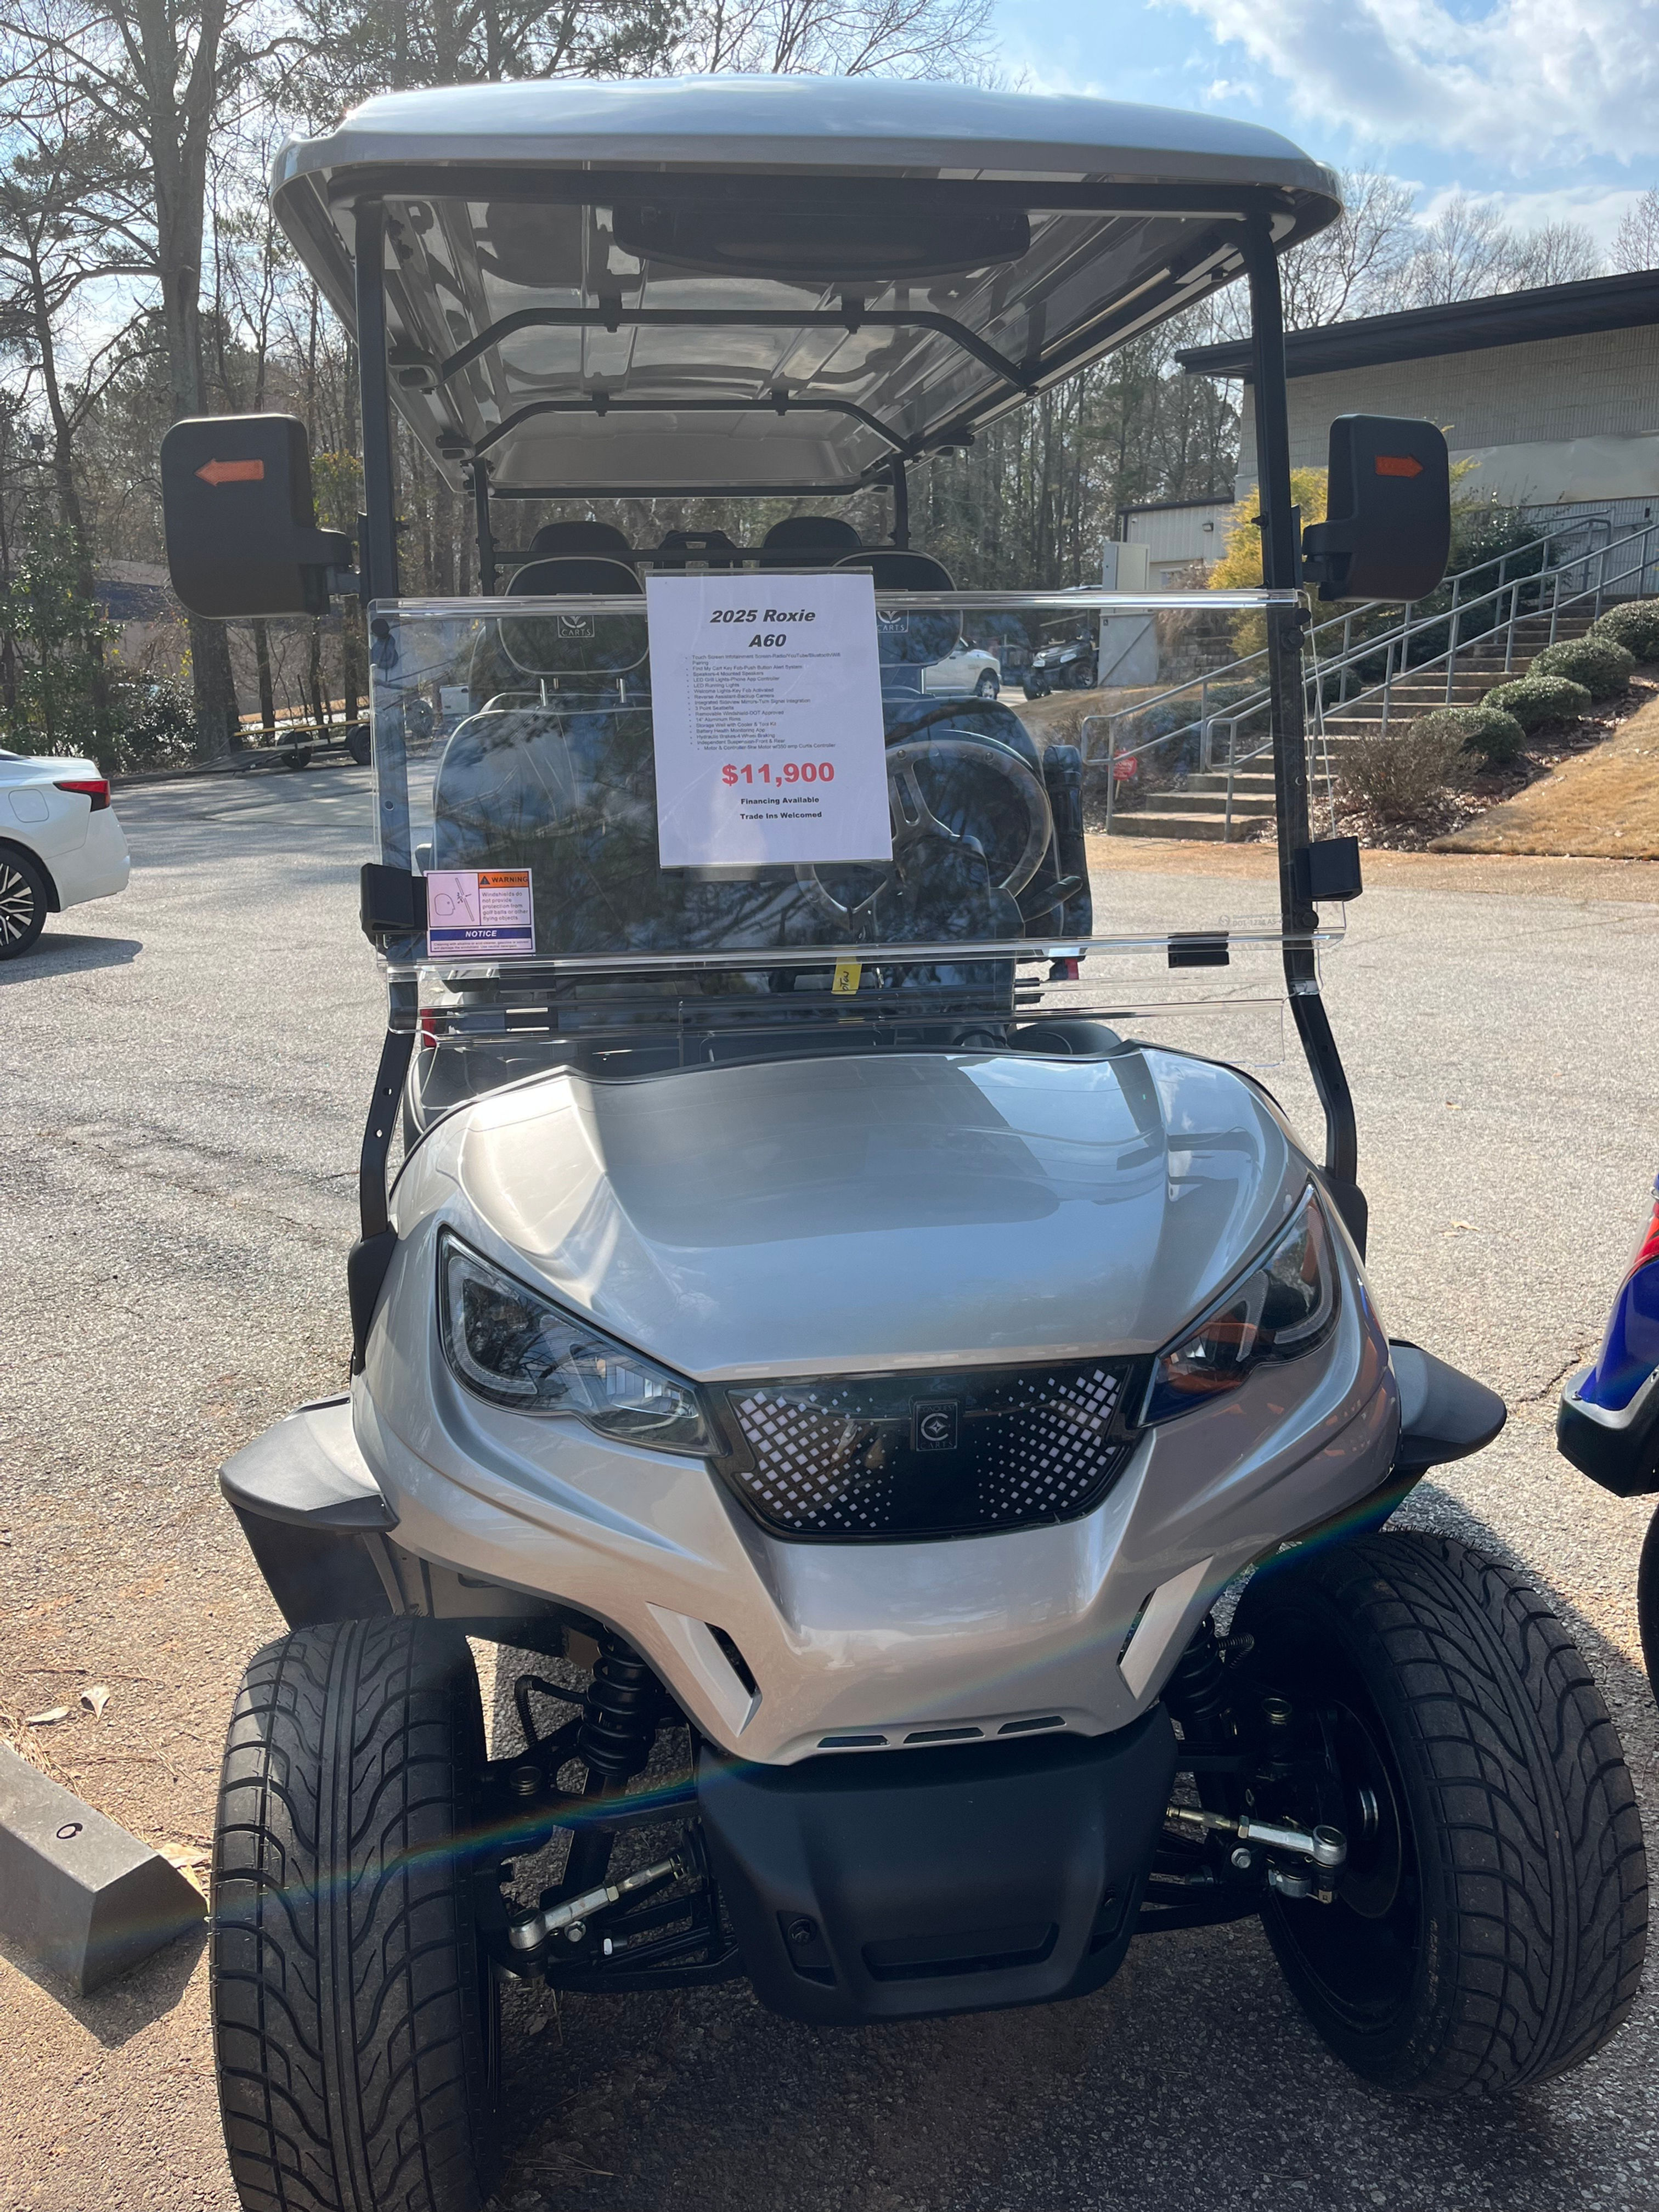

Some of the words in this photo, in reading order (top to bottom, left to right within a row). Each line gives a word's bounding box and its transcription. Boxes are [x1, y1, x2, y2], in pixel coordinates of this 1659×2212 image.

[709, 610, 758, 623] 2025
[763, 609, 816, 622] Roxie
[748, 634, 787, 647] A60
[721, 762, 834, 788] $11,900
